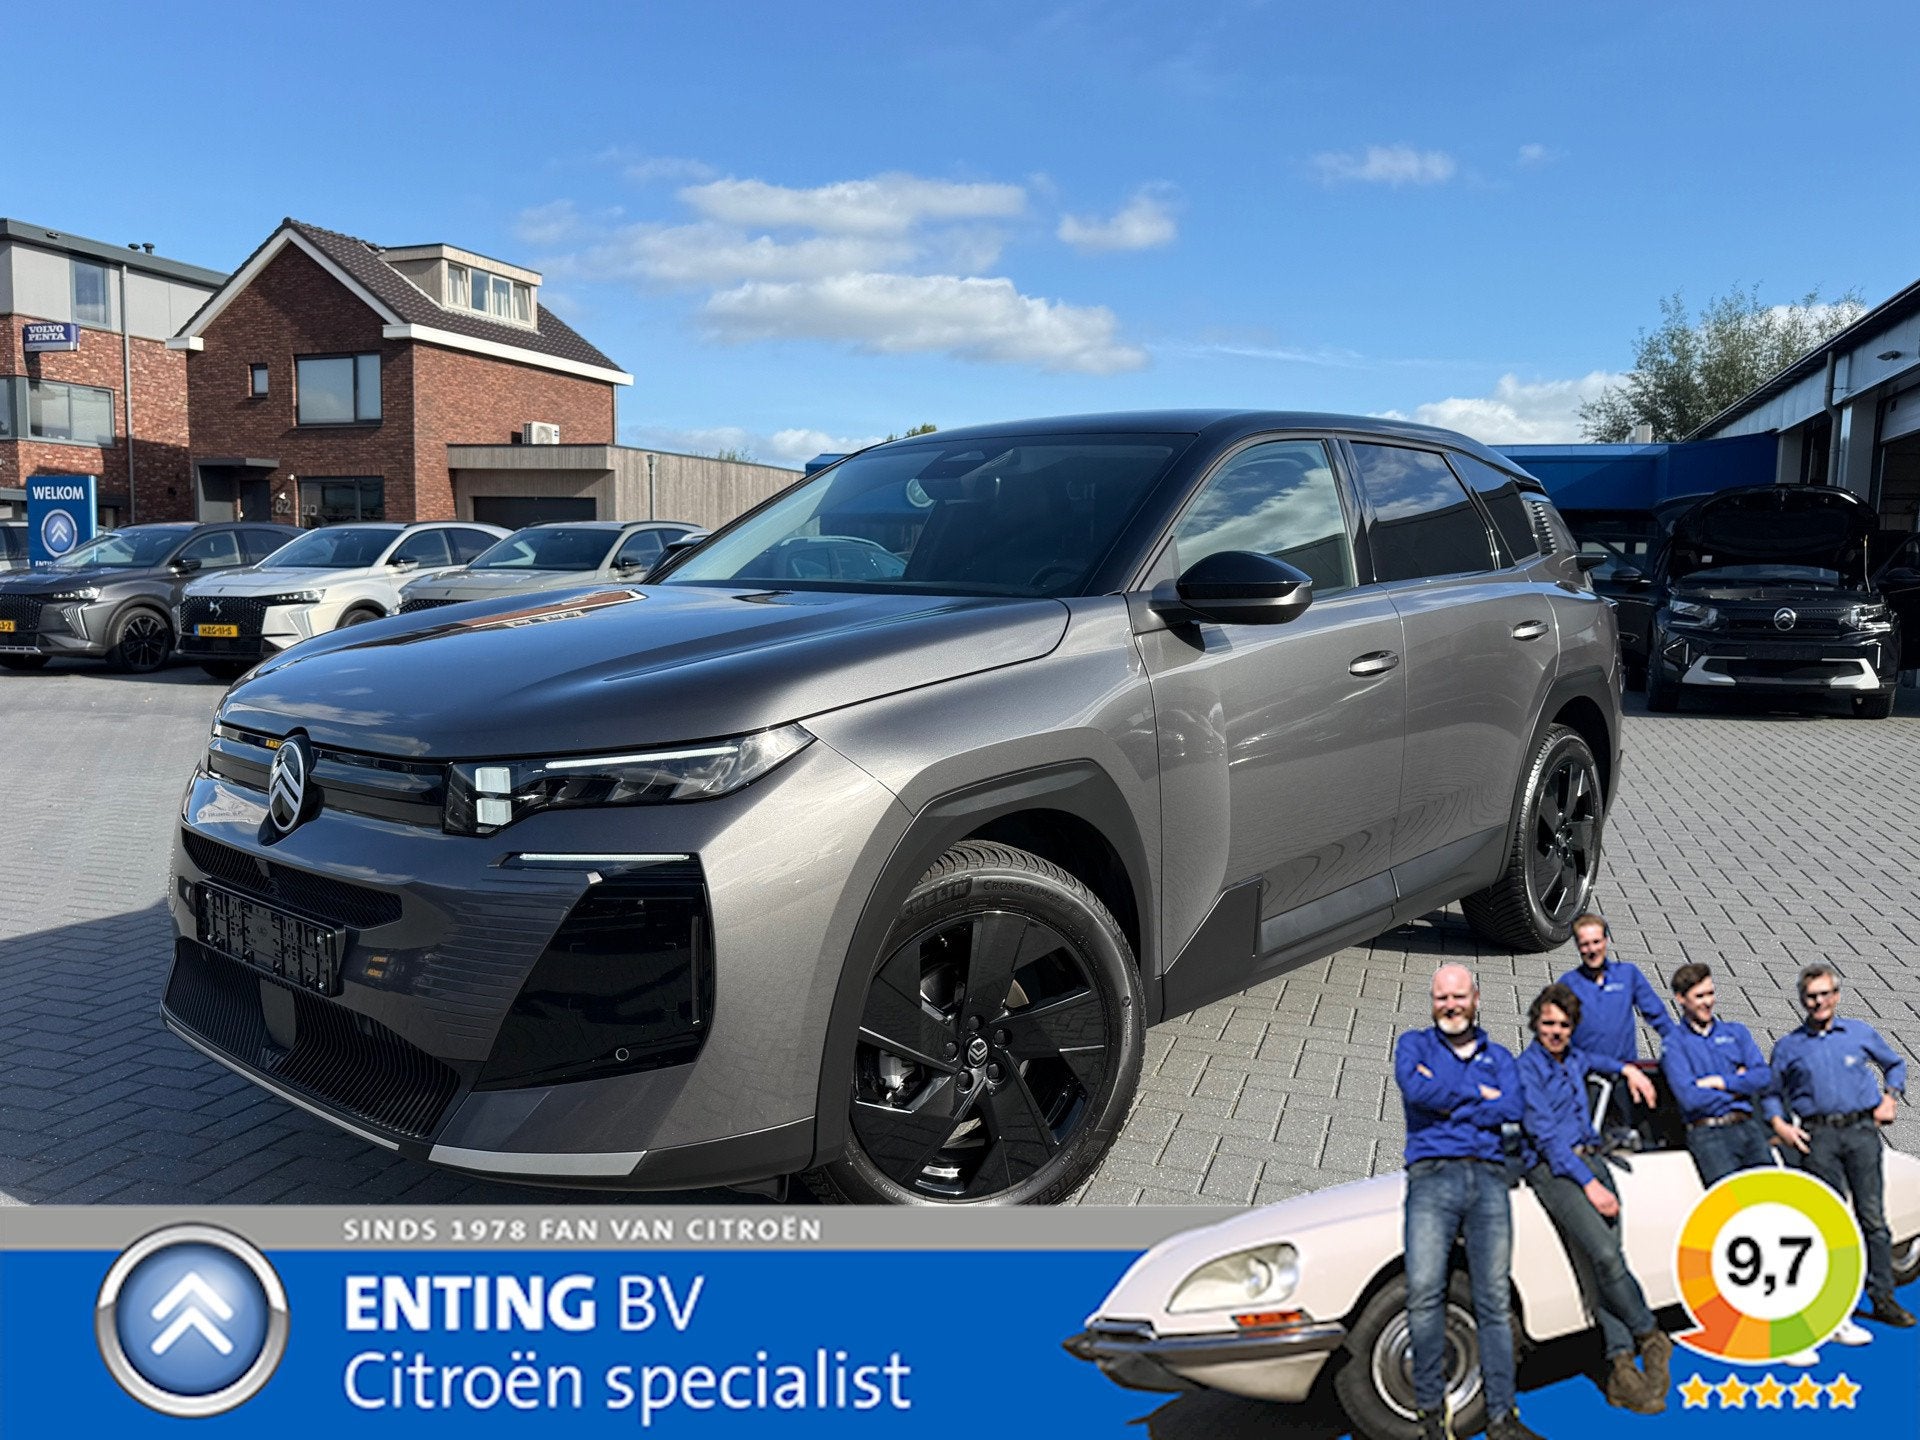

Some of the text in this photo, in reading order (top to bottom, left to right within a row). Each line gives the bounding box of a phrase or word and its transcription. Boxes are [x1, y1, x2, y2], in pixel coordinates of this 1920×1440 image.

[28, 325, 65, 333] VOLVO
[28, 333, 67, 341] PENTA
[32, 486, 84, 500] WELKOM
[275, 499, 291, 514] 82
